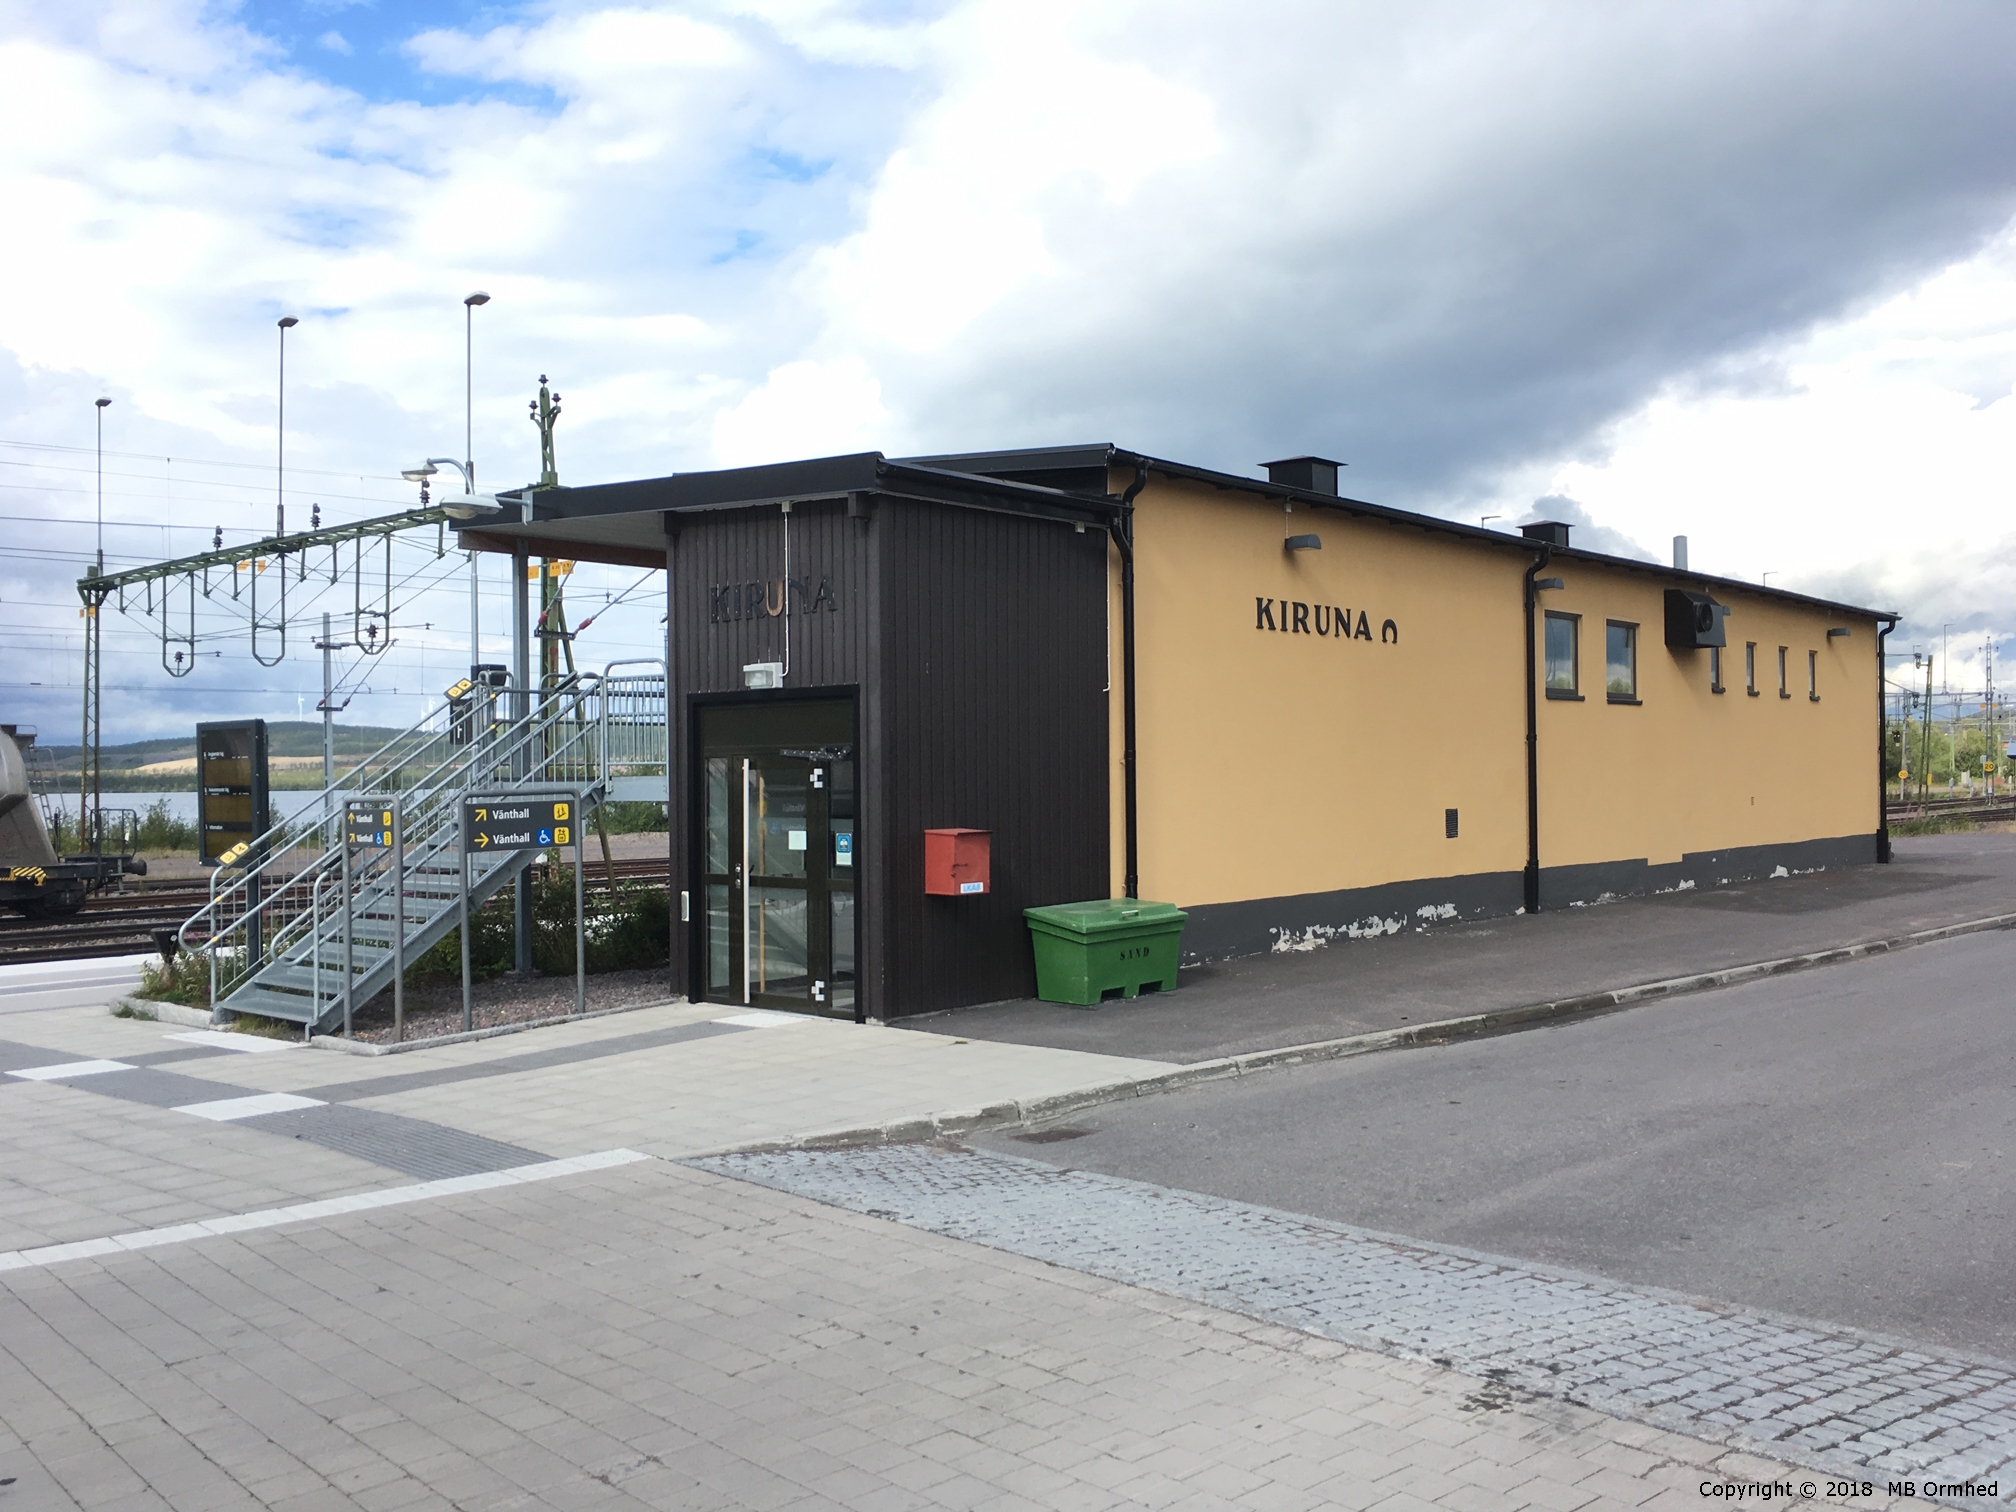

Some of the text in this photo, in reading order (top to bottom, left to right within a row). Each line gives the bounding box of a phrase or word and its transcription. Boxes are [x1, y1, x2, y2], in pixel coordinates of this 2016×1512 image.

[710, 574, 837, 623] KIRUNA
[1255, 597, 1373, 641] KIRUNA
[492, 808, 530, 820] Vänthall
[492, 832, 530, 845] Vänthall
[963, 883, 981, 892] LKAB
[1119, 947, 1150, 961] SAND
